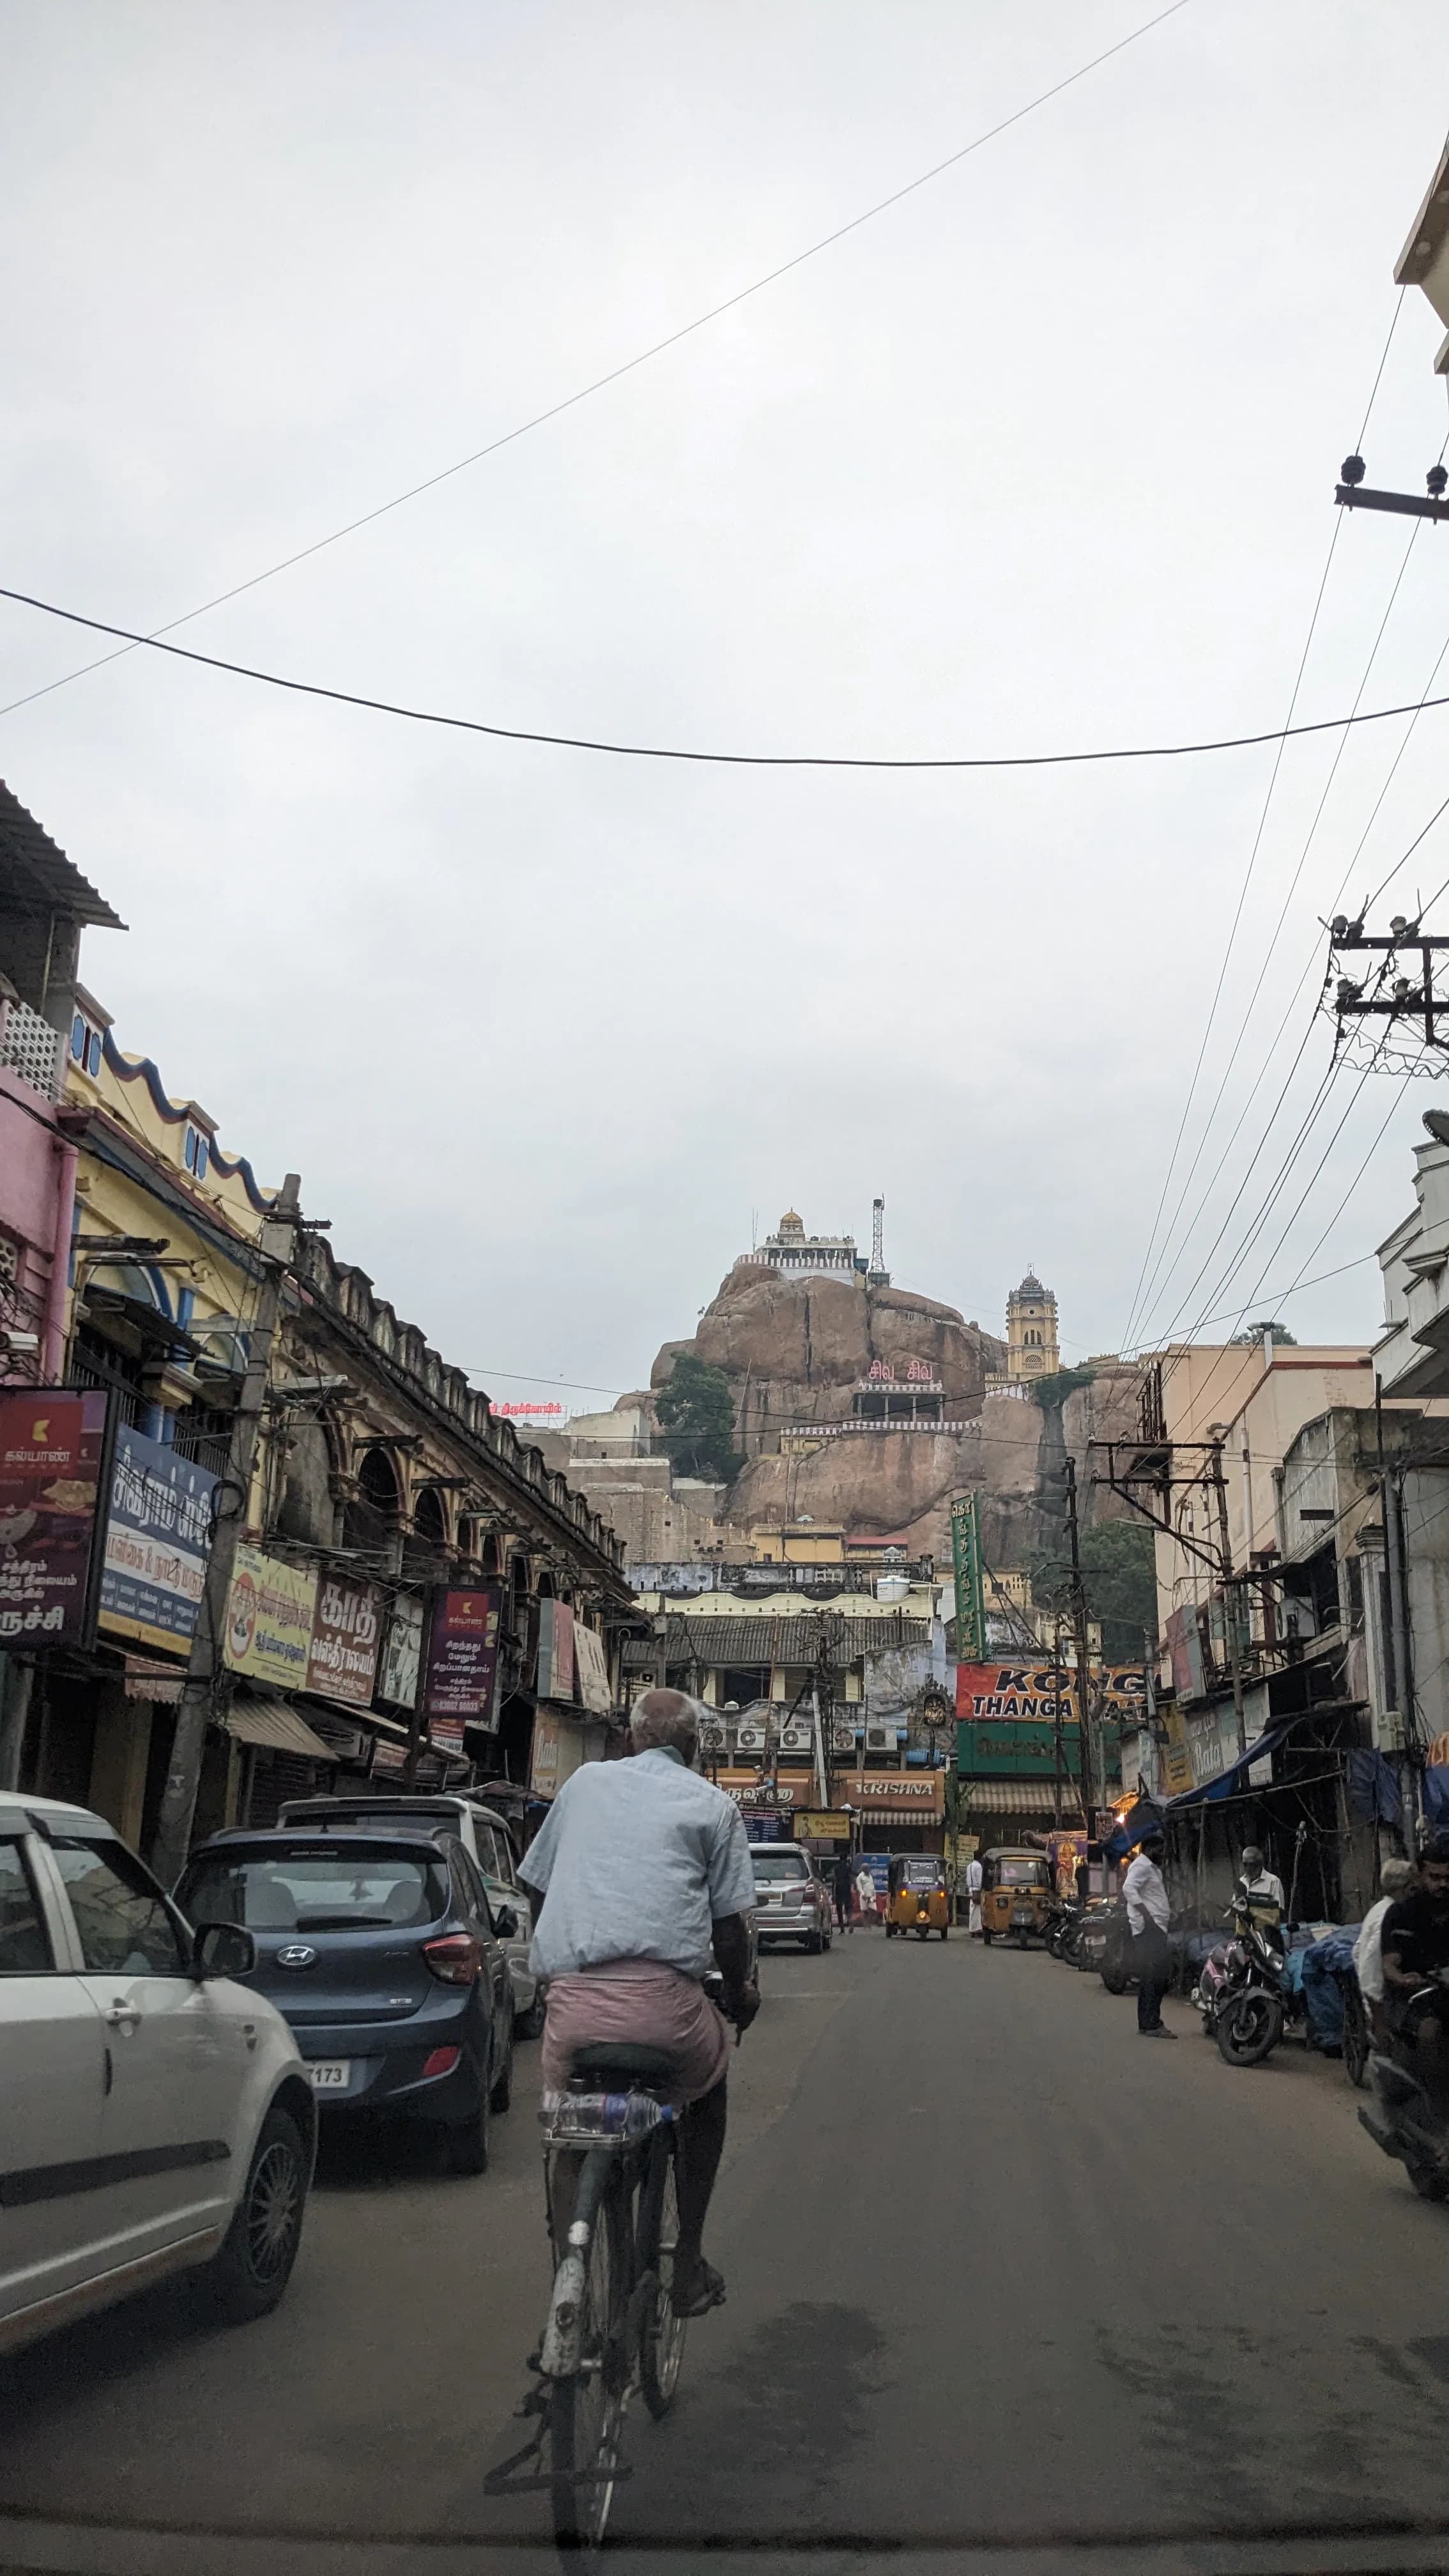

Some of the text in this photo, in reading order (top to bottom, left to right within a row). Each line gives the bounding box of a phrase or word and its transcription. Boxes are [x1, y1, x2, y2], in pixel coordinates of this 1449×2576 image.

[869, 1360, 932, 1379] சிவ சிவ
[5, 1446, 71, 1462] கல்யாண்
[448, 1615, 482, 1625] கல்யாண்
[972, 1695, 1074, 1717] THANGA
[855, 1782, 933, 1795] KRISHNA
